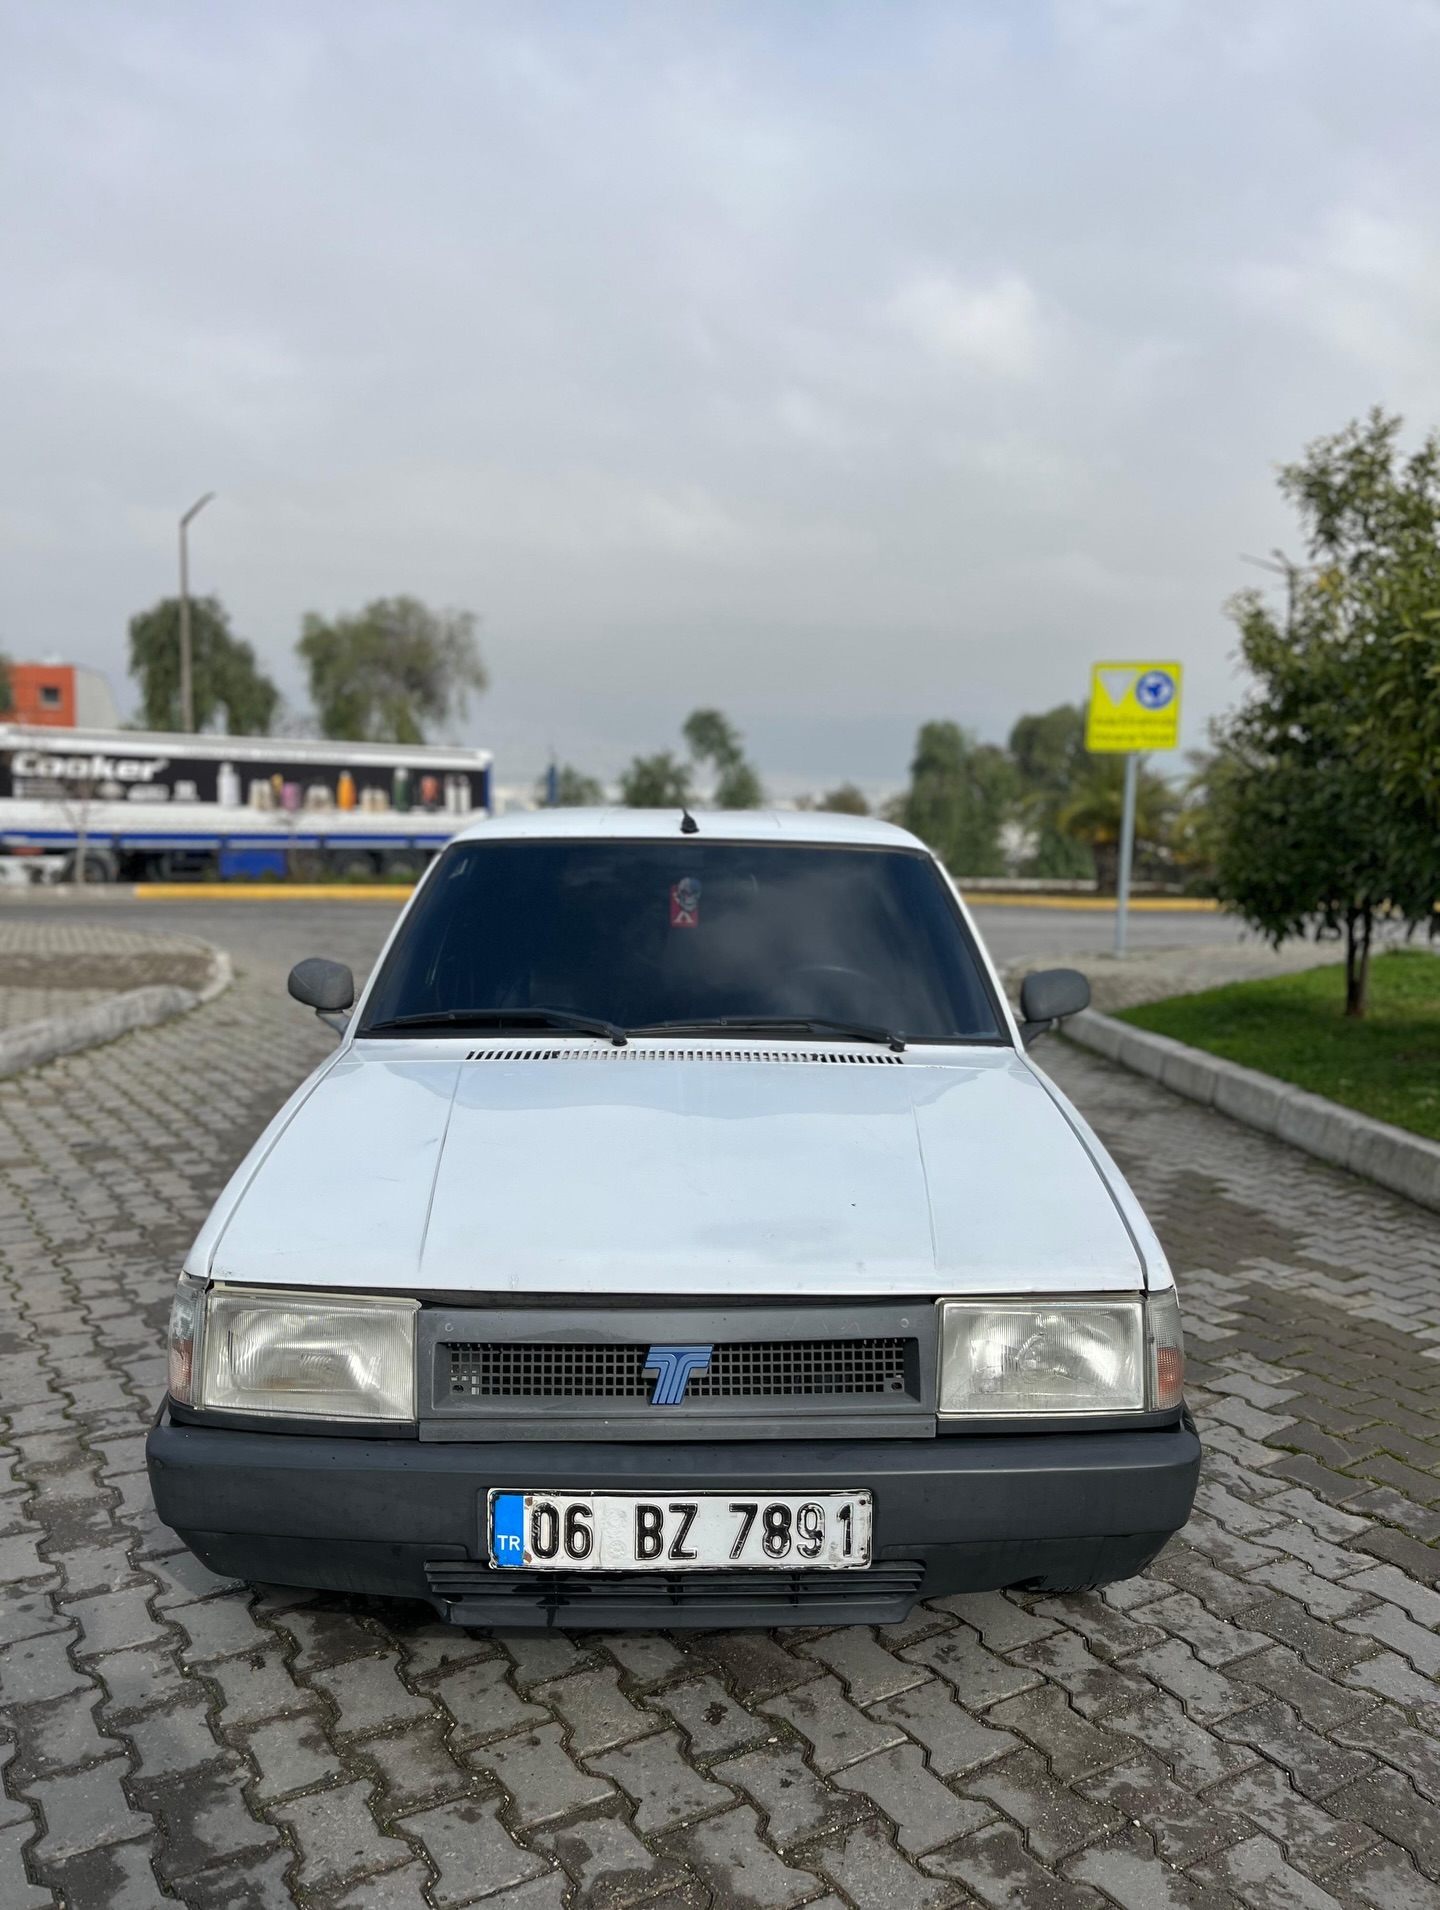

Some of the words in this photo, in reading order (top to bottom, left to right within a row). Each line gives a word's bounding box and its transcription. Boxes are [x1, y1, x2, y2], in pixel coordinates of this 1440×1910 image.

[11, 751, 169, 781] Cooker
[497, 1534, 521, 1551] TR
[531, 1502, 594, 1561] 06
[634, 1502, 698, 1560] BZ
[729, 1502, 854, 1560] 7891
